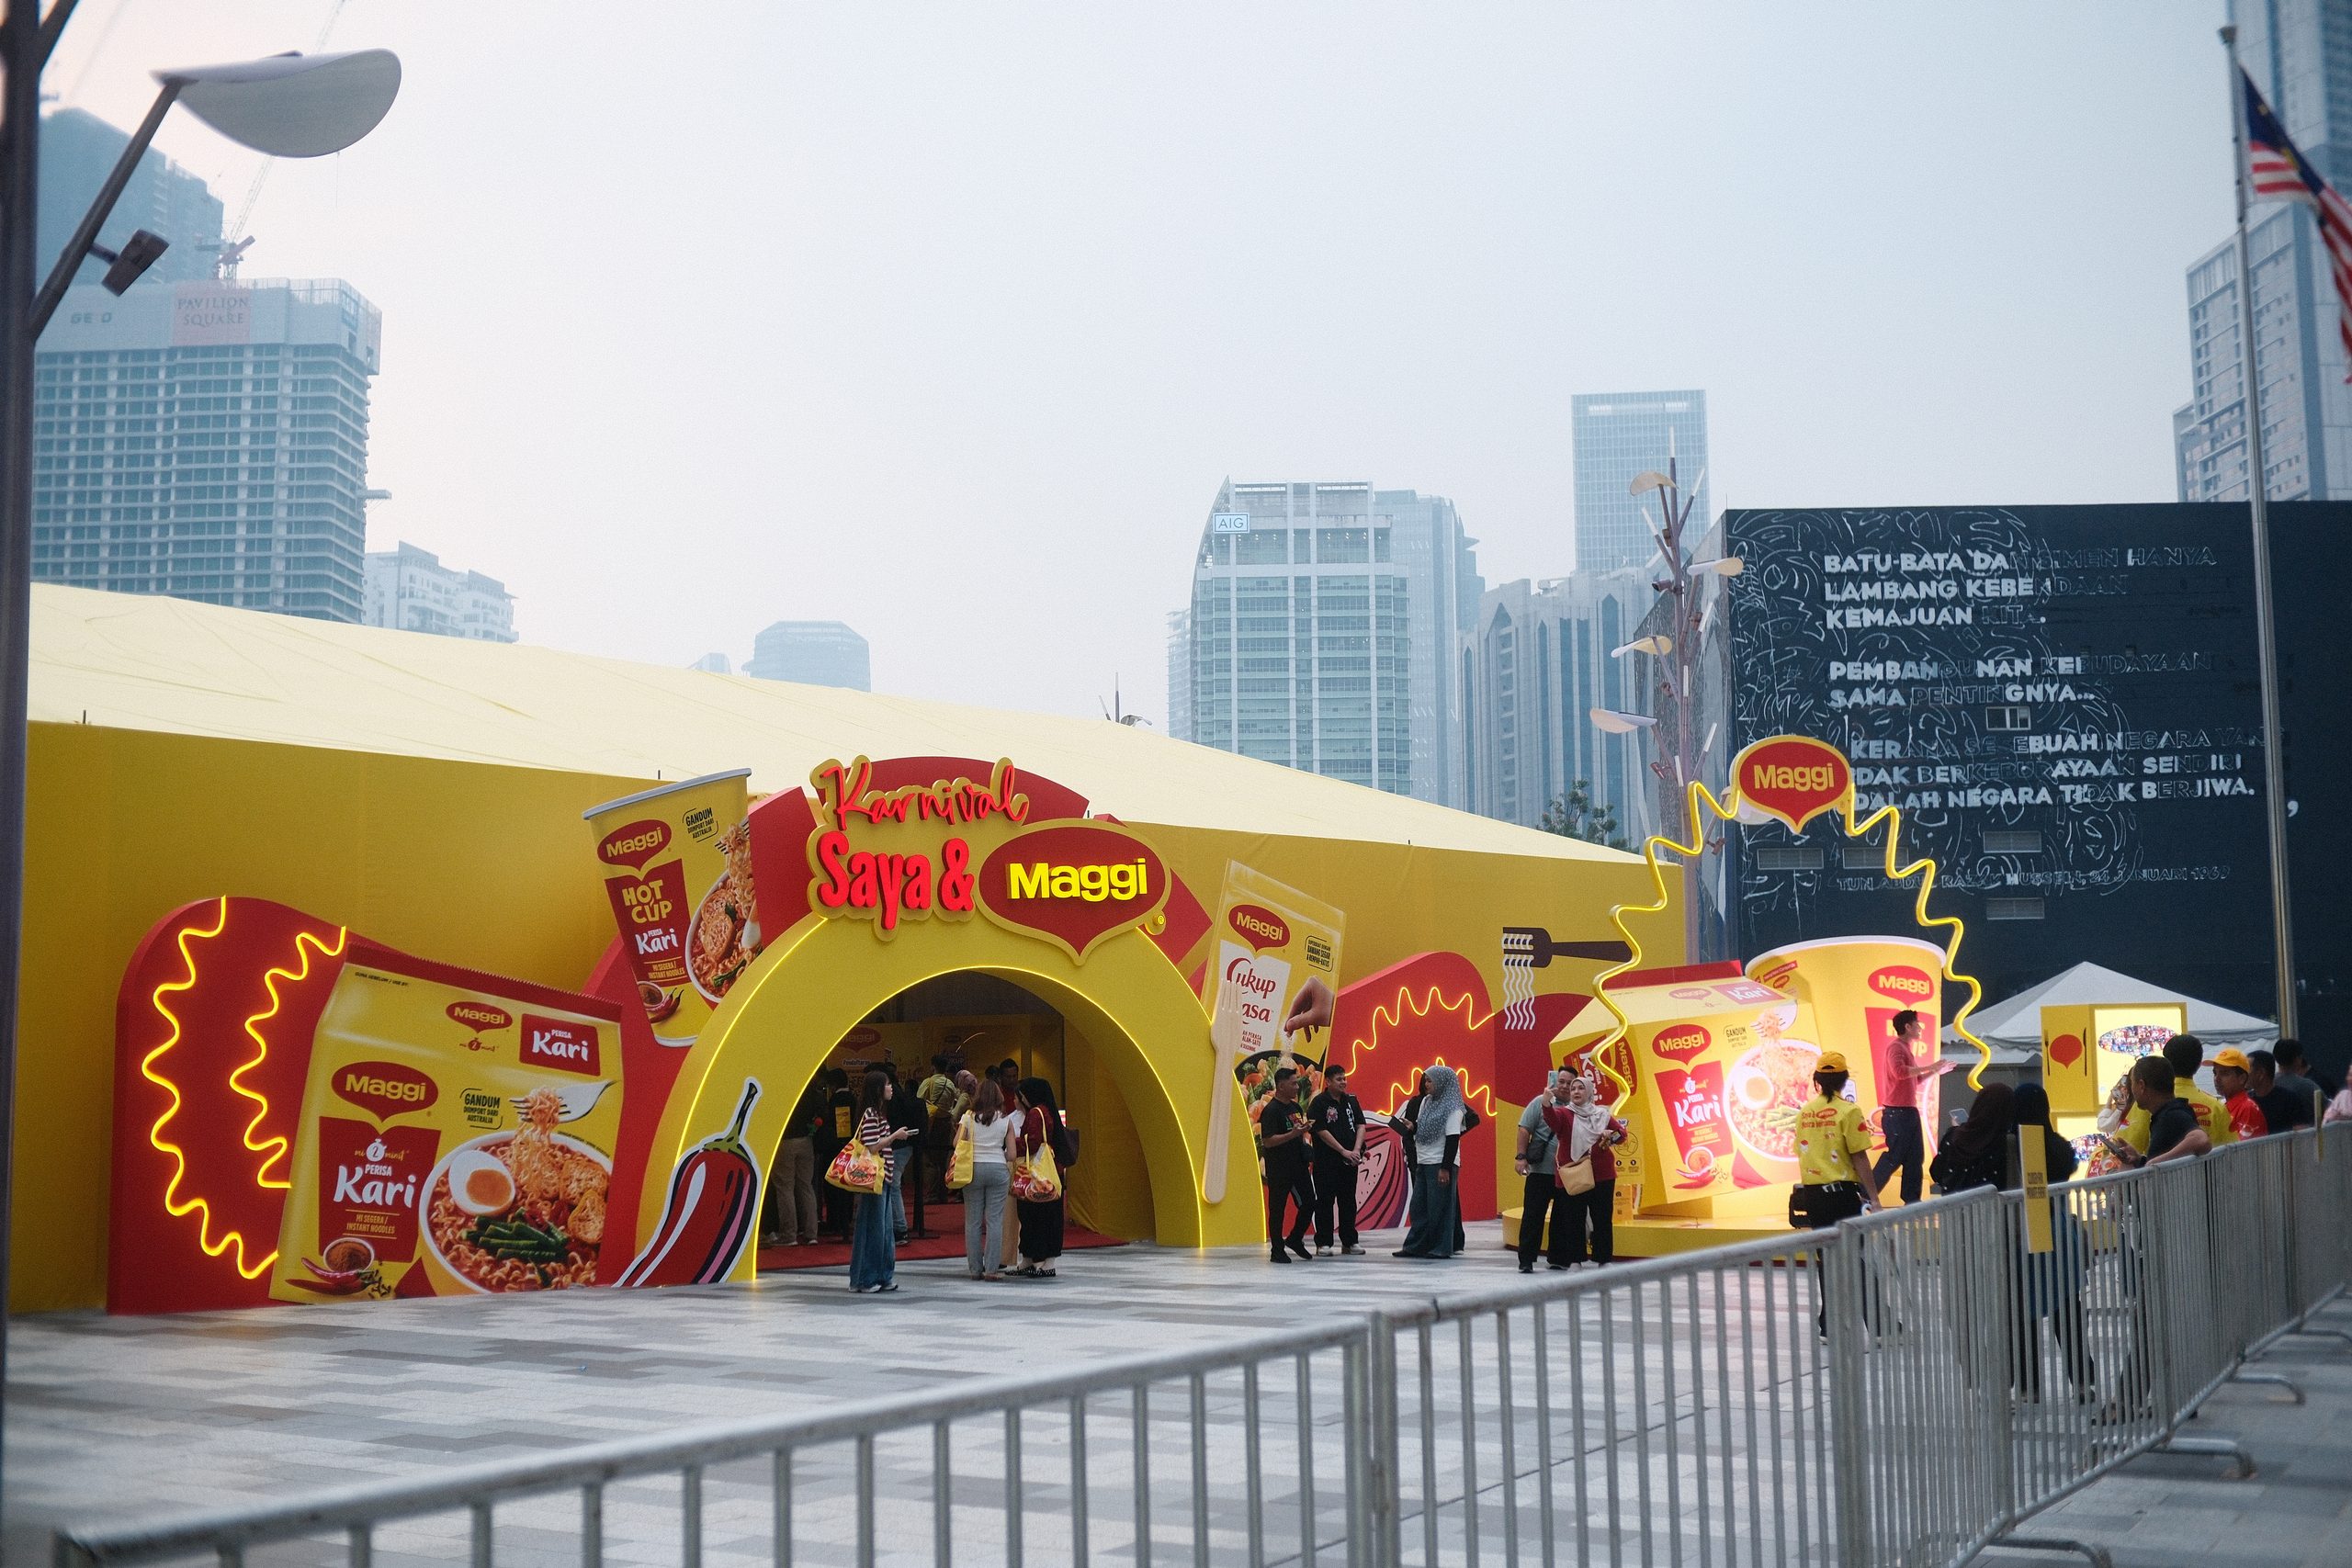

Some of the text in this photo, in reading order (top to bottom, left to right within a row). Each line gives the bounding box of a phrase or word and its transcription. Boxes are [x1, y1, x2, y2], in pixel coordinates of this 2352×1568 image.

[177, 297, 249, 310] PAVILION
[183, 312, 244, 327] SQUARE
[1218, 517, 1244, 529] AIG
[1824, 551, 1966, 573] BATU-BATA
[2127, 547, 2217, 567] HANYA
[1825, 579, 1958, 602] LAMBANG
[1826, 606, 1973, 629] KEMAJUAN
[1829, 659, 2032, 681] PEMBANGUNAN
[1829, 687, 1906, 707] SAMA
[2106, 728, 2212, 751] NEGARA
[2143, 753, 2242, 775] SENDIRI
[1753, 762, 1835, 792] Maggi
[820, 761, 1028, 830] Karnival
[1855, 776, 2256, 812] DALAH NEGARA TIDAK BERJIWA.
[685, 807, 713, 827] GANDUM
[605, 827, 663, 858] Maggi
[816, 829, 1148, 931] Saya & Maggi
[622, 879, 663, 907] HOT
[631, 898, 673, 924] CUP
[1236, 911, 1283, 941] Maggi
[635, 928, 679, 955] Kari
[1727, 987, 1772, 1000] Kari
[1878, 975, 1930, 994] Maggi
[454, 1007, 504, 1025] Maggi
[1241, 1003, 1272, 1023] asa
[1658, 1031, 1705, 1053] Maggi
[1725, 1026, 1747, 1038] GANDUM
[531, 1031, 589, 1062] Kari
[1618, 1042, 1635, 1089] Maggi
[345, 1074, 427, 1102] Maggi
[464, 1092, 501, 1109] GANDUM
[1674, 1094, 1722, 1128] Kari
[467, 1114, 494, 1124] AUSTRALIA
[364, 1164, 392, 1177] PERISA
[333, 1165, 417, 1209] Kari
